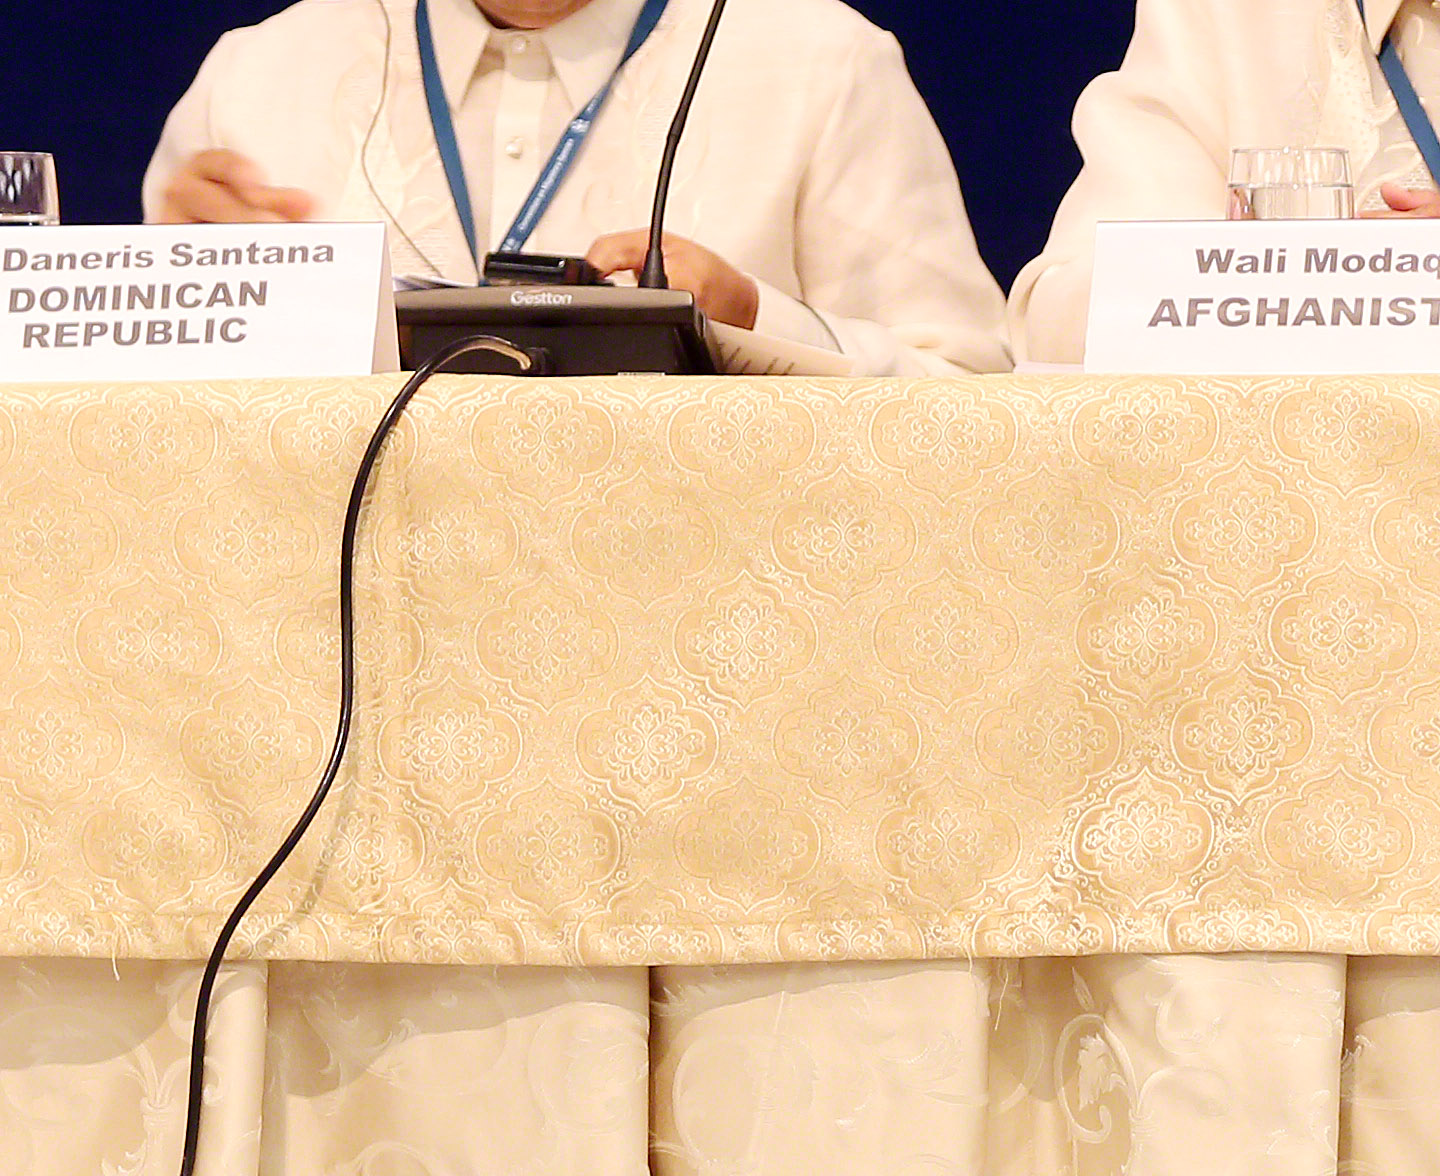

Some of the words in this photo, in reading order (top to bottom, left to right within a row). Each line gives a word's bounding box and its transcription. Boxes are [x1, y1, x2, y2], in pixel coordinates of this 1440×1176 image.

[2, 244, 155, 272] Daneris
[169, 240, 335, 268] Santana
[1195, 247, 1288, 275] Wali
[8, 280, 269, 314] DOMINICAN
[22, 317, 248, 349] REPUBLIC
